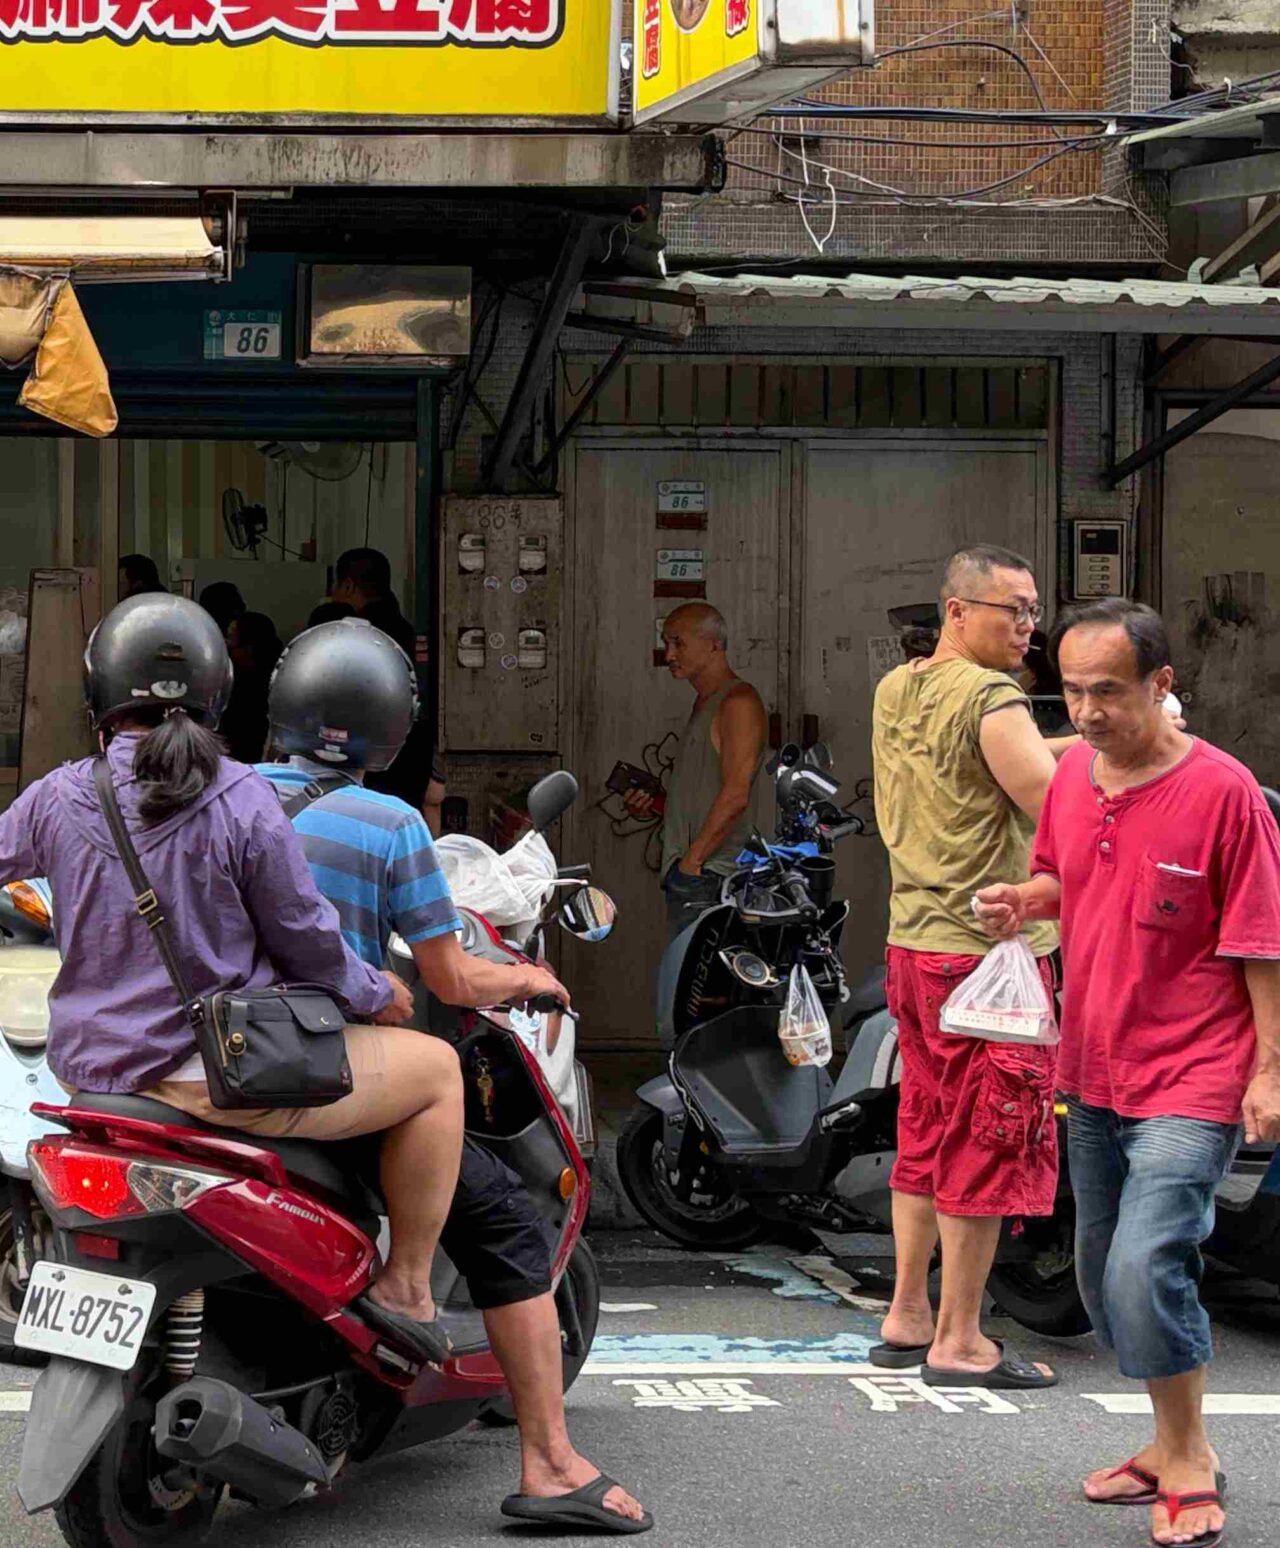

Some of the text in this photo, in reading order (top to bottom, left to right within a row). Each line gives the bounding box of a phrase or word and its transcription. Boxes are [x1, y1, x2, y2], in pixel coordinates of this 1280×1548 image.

[237, 327, 269, 353] 86
[671, 496, 689, 508] 86
[670, 564, 687, 576] 86
